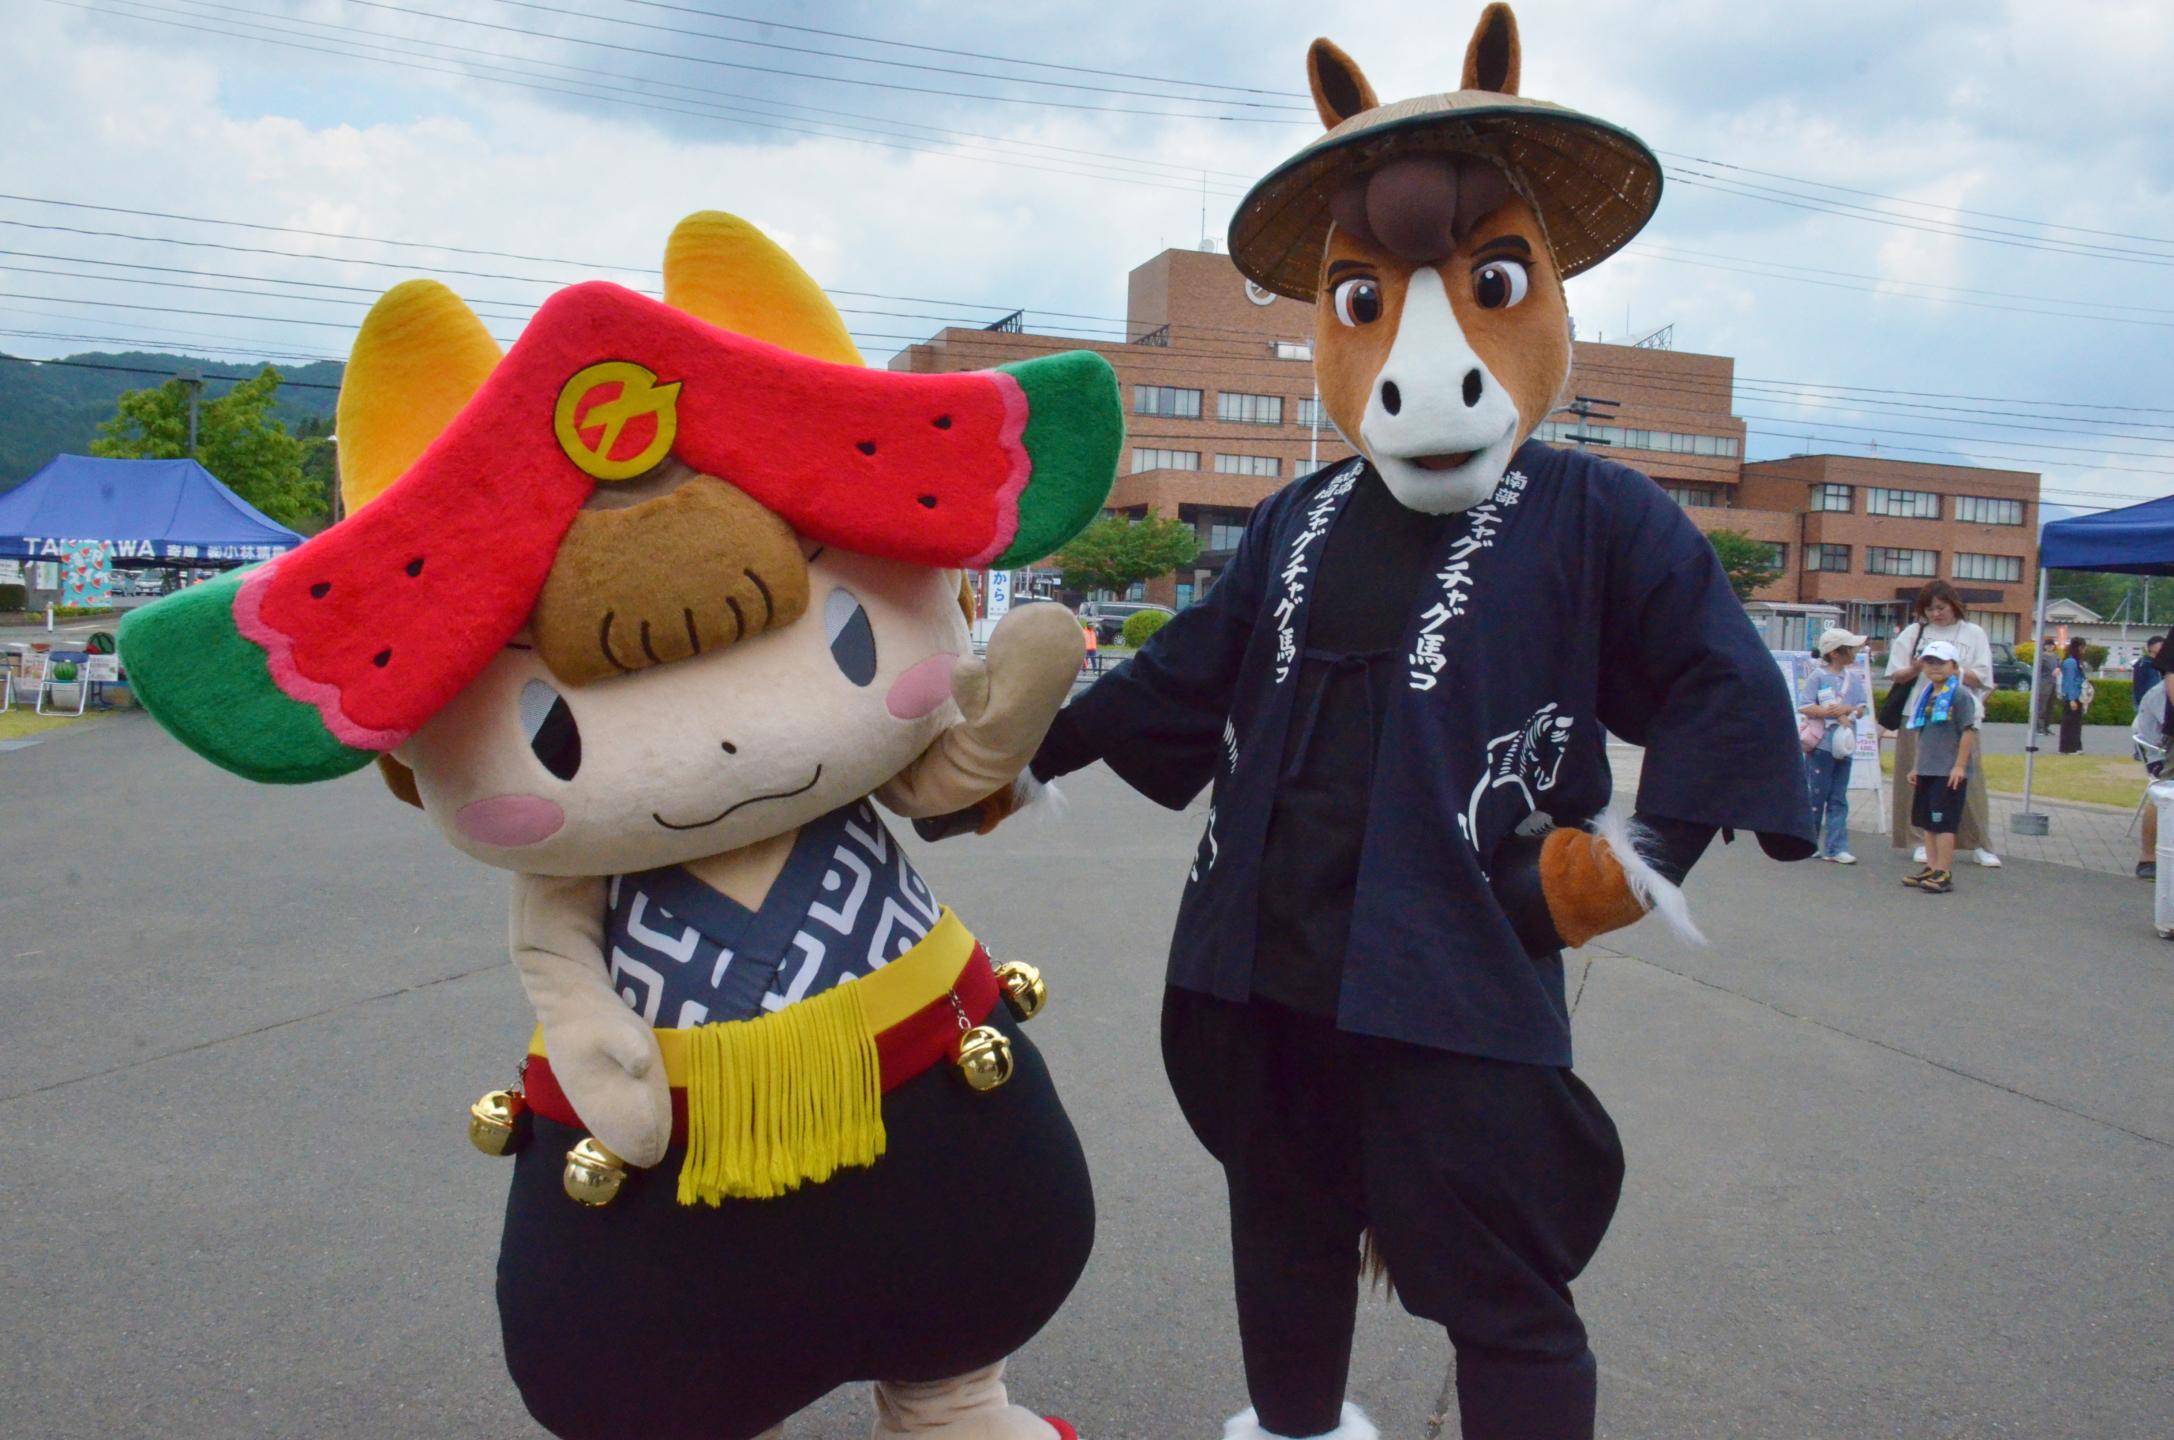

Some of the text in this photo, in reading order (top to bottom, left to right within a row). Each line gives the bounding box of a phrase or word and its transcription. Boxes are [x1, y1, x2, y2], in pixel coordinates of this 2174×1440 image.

[1495, 470, 1529, 507] 南部
[23, 537, 156, 558] TAWA
[1273, 497, 1336, 684] チャグチャグ馬コ
[1408, 504, 1503, 691] チャグチャグ馬コ
